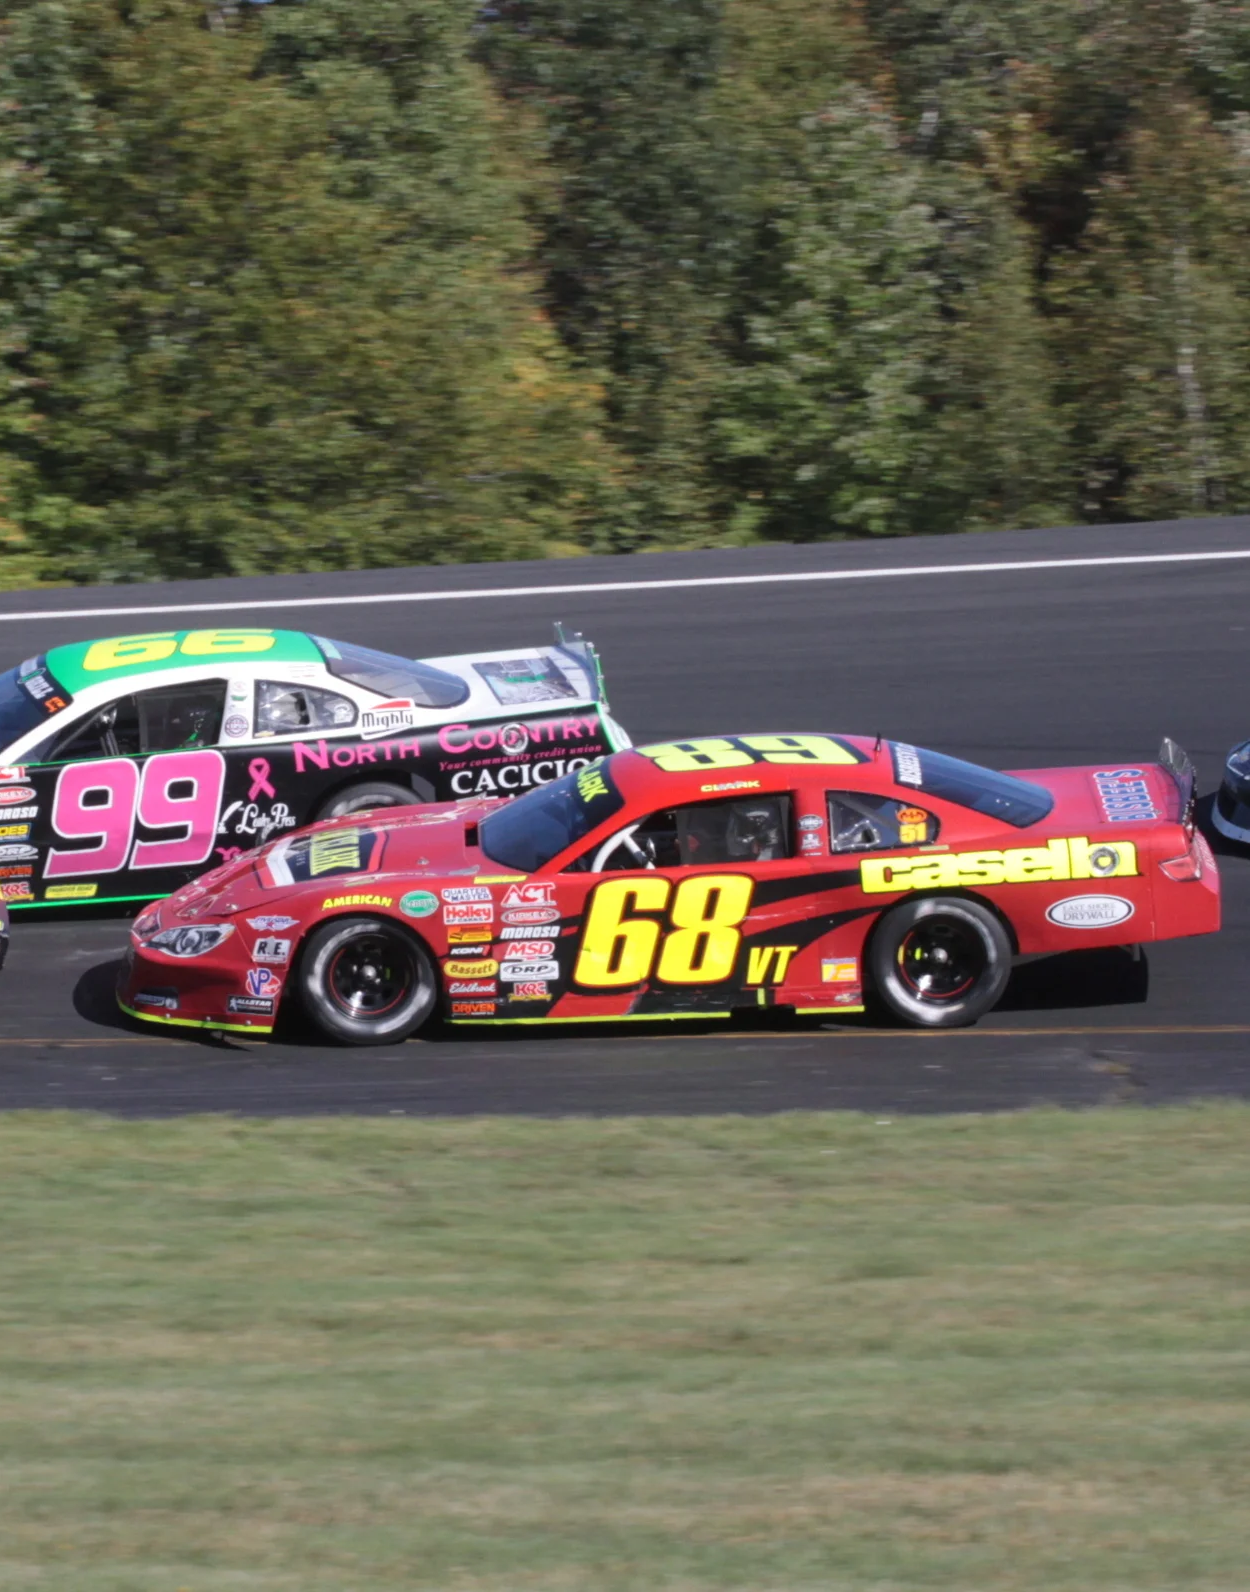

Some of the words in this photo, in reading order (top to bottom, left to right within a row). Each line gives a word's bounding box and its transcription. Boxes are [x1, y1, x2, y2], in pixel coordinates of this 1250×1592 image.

[362, 710, 413, 728] Mighty
[292, 738, 421, 773] NORTH
[439, 761, 466, 771] Your
[470, 754, 531, 766] community
[534, 747, 566, 759] credit
[570, 744, 603, 754] union
[451, 755, 604, 794] CACICIO
[1094, 769, 1158, 823] BISBEE'S
[43, 749, 226, 879] 99
[900, 822, 927, 843] 51
[860, 836, 1141, 894] casella
[444, 888, 488, 899] QUARTER
[452, 892, 490, 901] MASTER
[322, 894, 393, 911] AMERICAN
[1088, 902, 1116, 910] SHORE
[446, 905, 490, 921] Holley
[1063, 910, 1118, 921] DRYWALL
[500, 926, 560, 939] MOROSO
[573, 873, 755, 988] 68
[450, 947, 483, 955] KONI
[507, 942, 554, 956] MSD
[451, 963, 493, 974] Bassett
[511, 965, 548, 974] DRP
[746, 945, 798, 984] VT
[515, 982, 547, 996] KRC
[452, 1002, 495, 1013] DRIVEN
